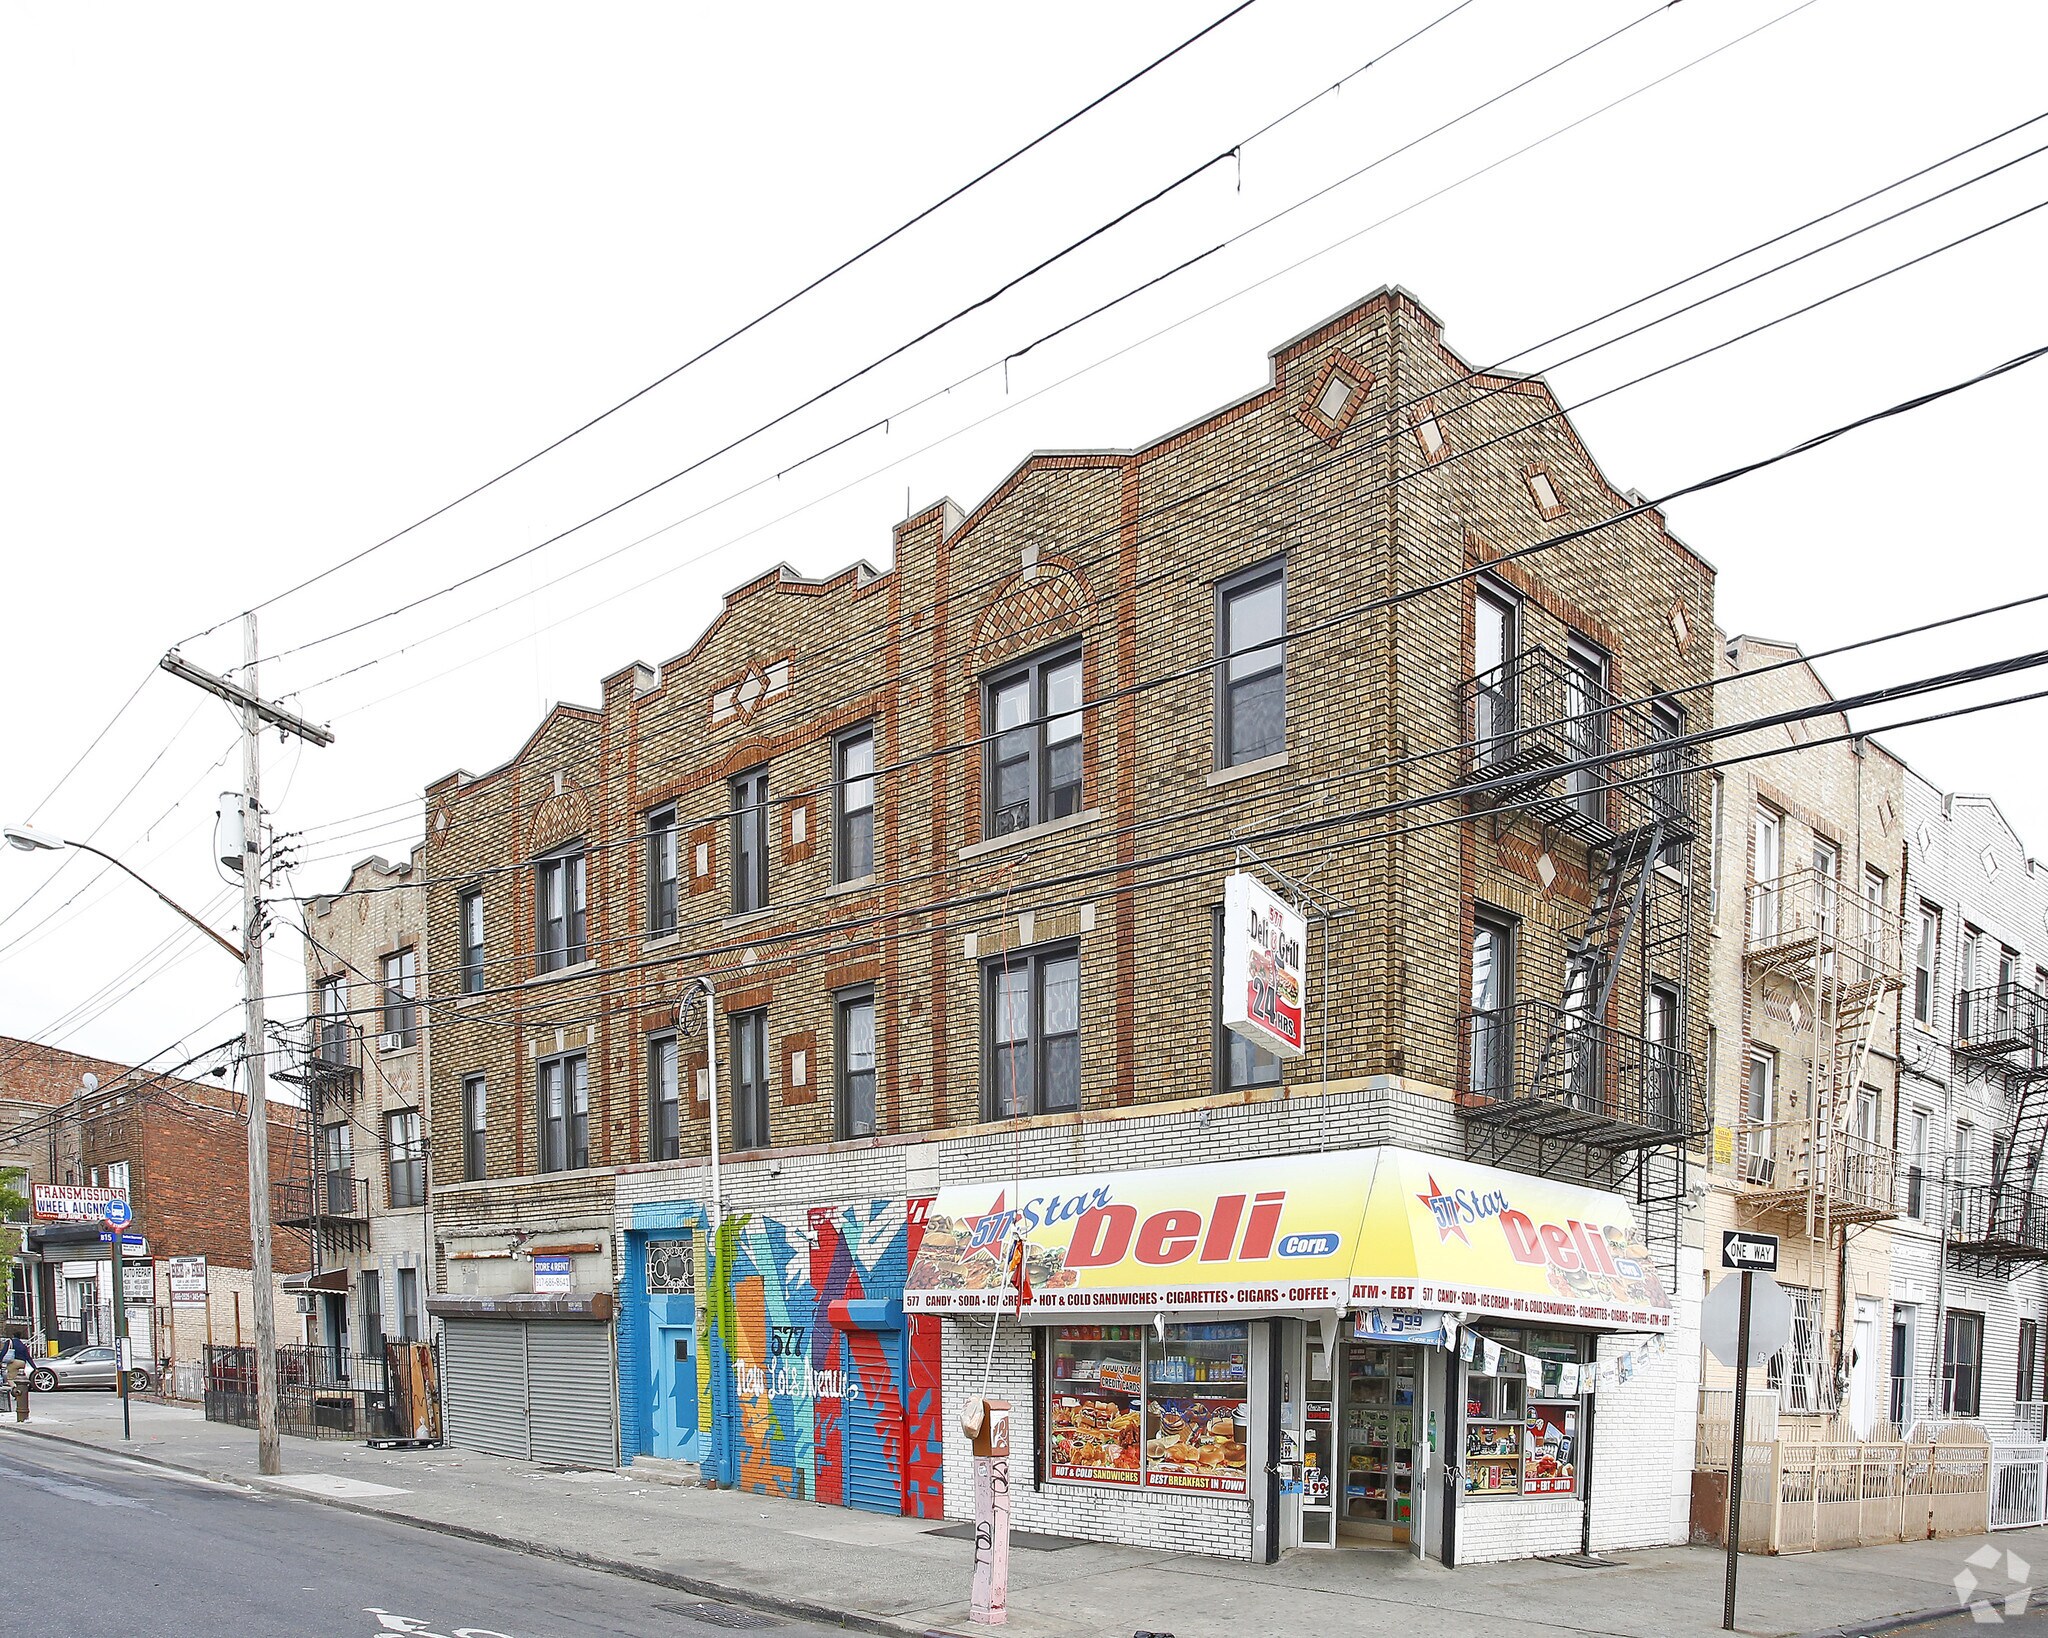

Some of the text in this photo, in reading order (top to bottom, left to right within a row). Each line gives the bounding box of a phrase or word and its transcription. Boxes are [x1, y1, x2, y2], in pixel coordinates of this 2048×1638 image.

[1269, 907, 1283, 928] 577
[1250, 909, 1269, 949] Deli
[1278, 932, 1299, 970] Grill
[1253, 976, 1296, 1039] 24 HRS.
[36, 1185, 126, 1201] TRANSMISSIONS
[37, 1200, 69, 1213] WHEEL
[972, 1210, 1017, 1247] 577
[1019, 1184, 1114, 1235] Star
[1431, 1188, 1509, 1228] 577 Star
[1064, 1191, 1287, 1268] Deli
[1285, 1236, 1329, 1254] Corp.
[1499, 1208, 1618, 1277] Deli
[1730, 1243, 1771, 1260] ONE WAY
[535, 1262, 551, 1272] STORE
[554, 1262, 569, 1272] RENT
[906, 1295, 919, 1307] 577
[925, 1295, 952, 1306] CANDY
[958, 1294, 980, 1306] SODA
[1039, 1294, 1057, 1306] HOT
[1058, 1295, 1065, 1306] &
[1067, 1293, 1090, 1306] COLD
[1092, 1291, 1158, 1305] SANDWICHES
[1166, 1290, 1228, 1304] CIGARETTES
[1237, 1288, 1279, 1303] CIGARS
[1288, 1286, 1329, 1301] COFFEE
[1352, 1284, 1415, 1300] ATM EBT
[1422, 1287, 1670, 1327] 577 CANDY SODA ICE CREAM HOT & COLD SANDWICHES CIGARETTES CIGARS COFFEE ATM EBT
[771, 1326, 805, 1357] 577
[732, 1357, 765, 1397] New
[767, 1356, 800, 1401] Lots
[1101, 1377, 1140, 1393] CREDIT CARDS
[1055, 1467, 1139, 1483] HOT & COLD SANDWICHES
[1150, 1474, 1245, 1491] BEST BREAKFAST IN TOWN
[1525, 1480, 1571, 1492] ATM EBT LOTTO
